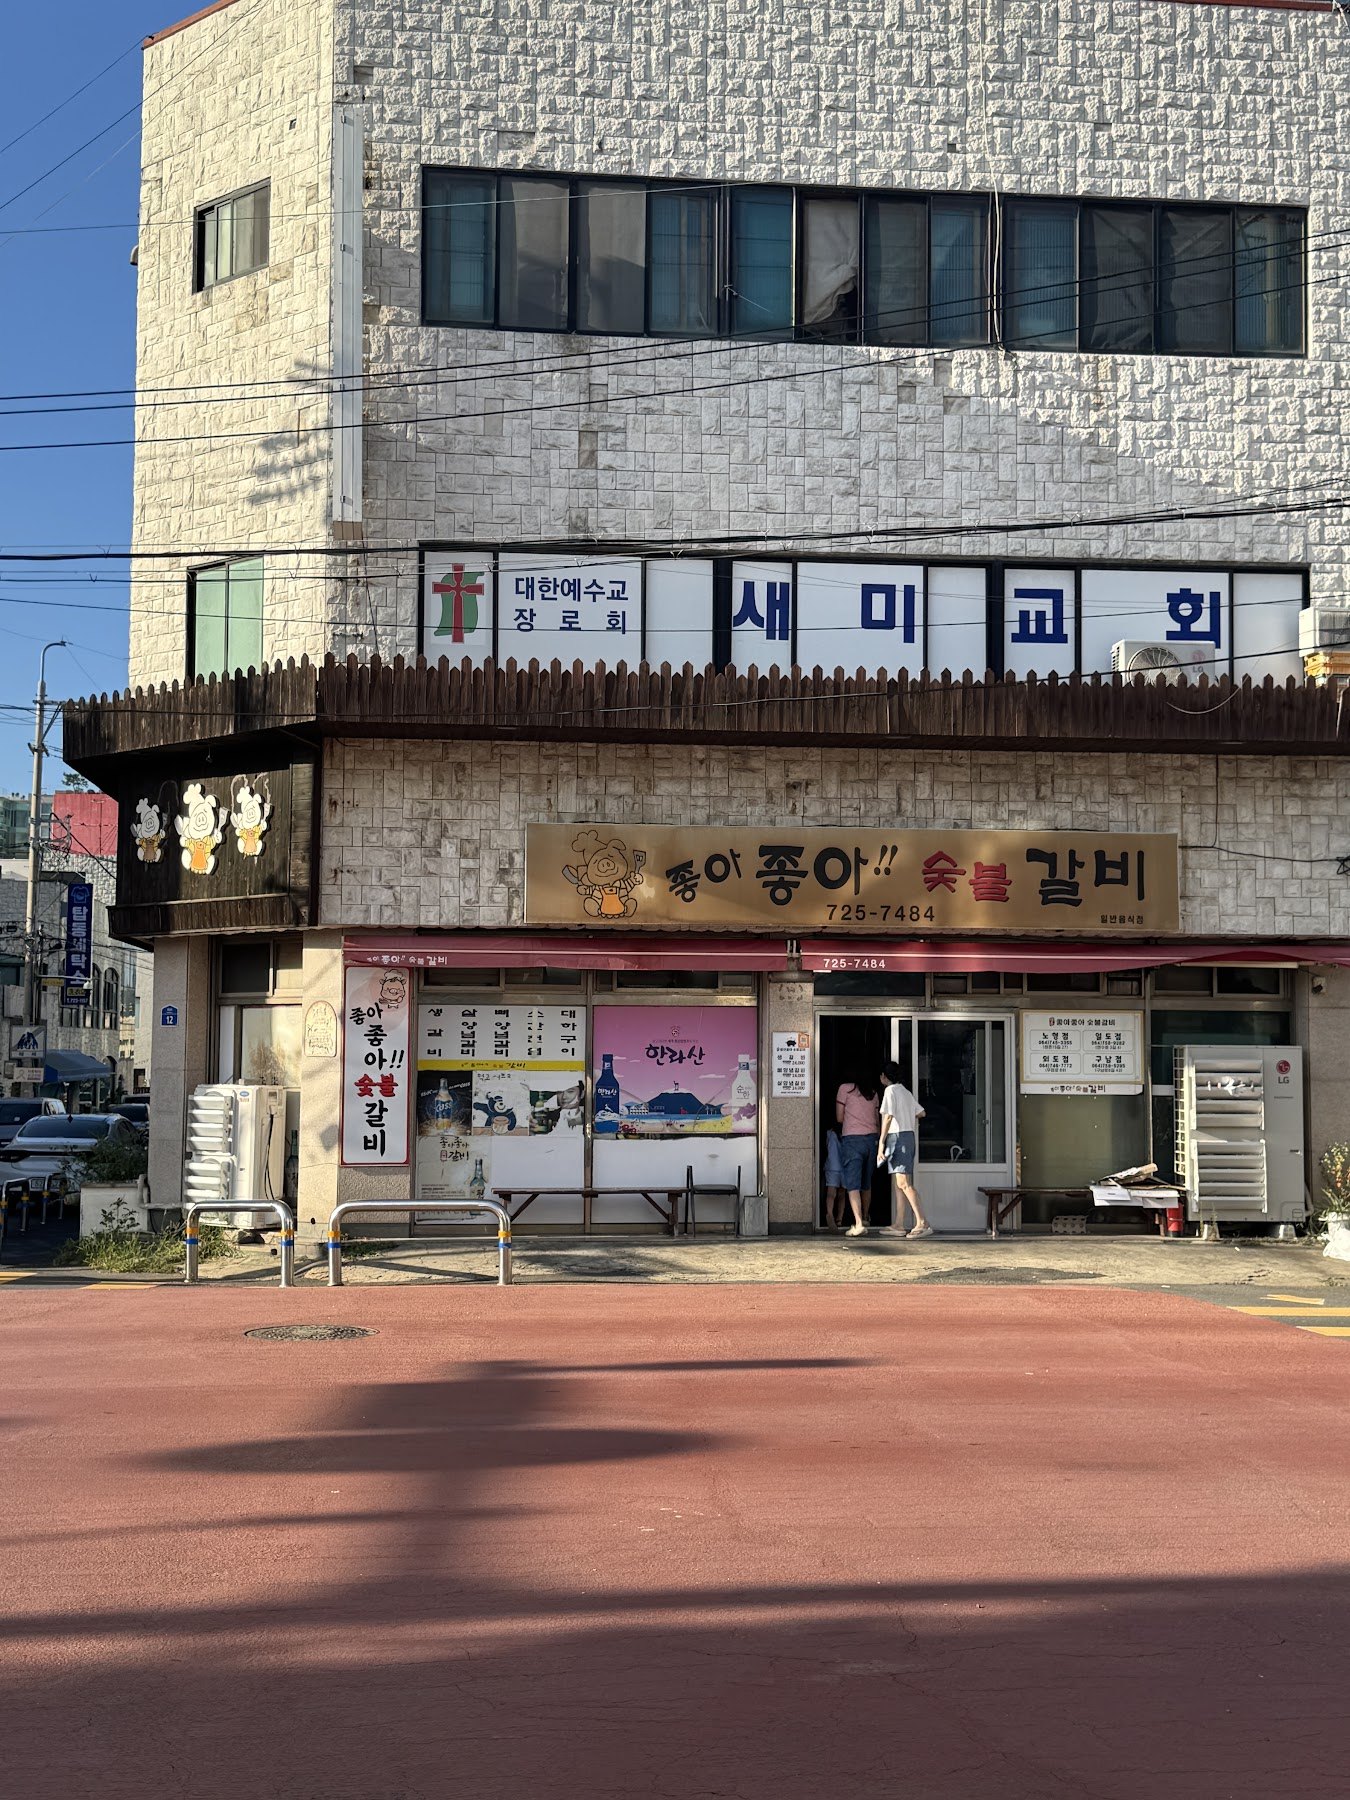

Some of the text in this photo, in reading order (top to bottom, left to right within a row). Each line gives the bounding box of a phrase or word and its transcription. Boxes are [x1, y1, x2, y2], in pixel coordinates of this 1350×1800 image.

[514, 576, 629, 603] 대한예수교
[664, 848, 744, 904] 좋아
[920, 850, 1014, 904] 숯불
[1025, 847, 1146, 907] 갈비
[826, 904, 937, 923] 725-7484
[1099, 913, 1146, 925] 일반음식점
[426, 955, 448, 966] 갈비
[823, 958, 886, 969] 725-7484
[166, 1015, 174, 1025] 12
[349, 1002, 384, 1025] 좋아
[426, 1008, 444, 1058] 생갈비
[460, 1008, 478, 1058] 살양념갈비
[493, 1009, 512, 1058] 뼈양념갈비
[560, 1009, 578, 1057] 대하구이
[644, 1043, 706, 1066] 한라산
[354, 1073, 399, 1098] 숯불
[362, 1099, 389, 1157] 갈비
[448, 1149, 470, 1162] 갈비
